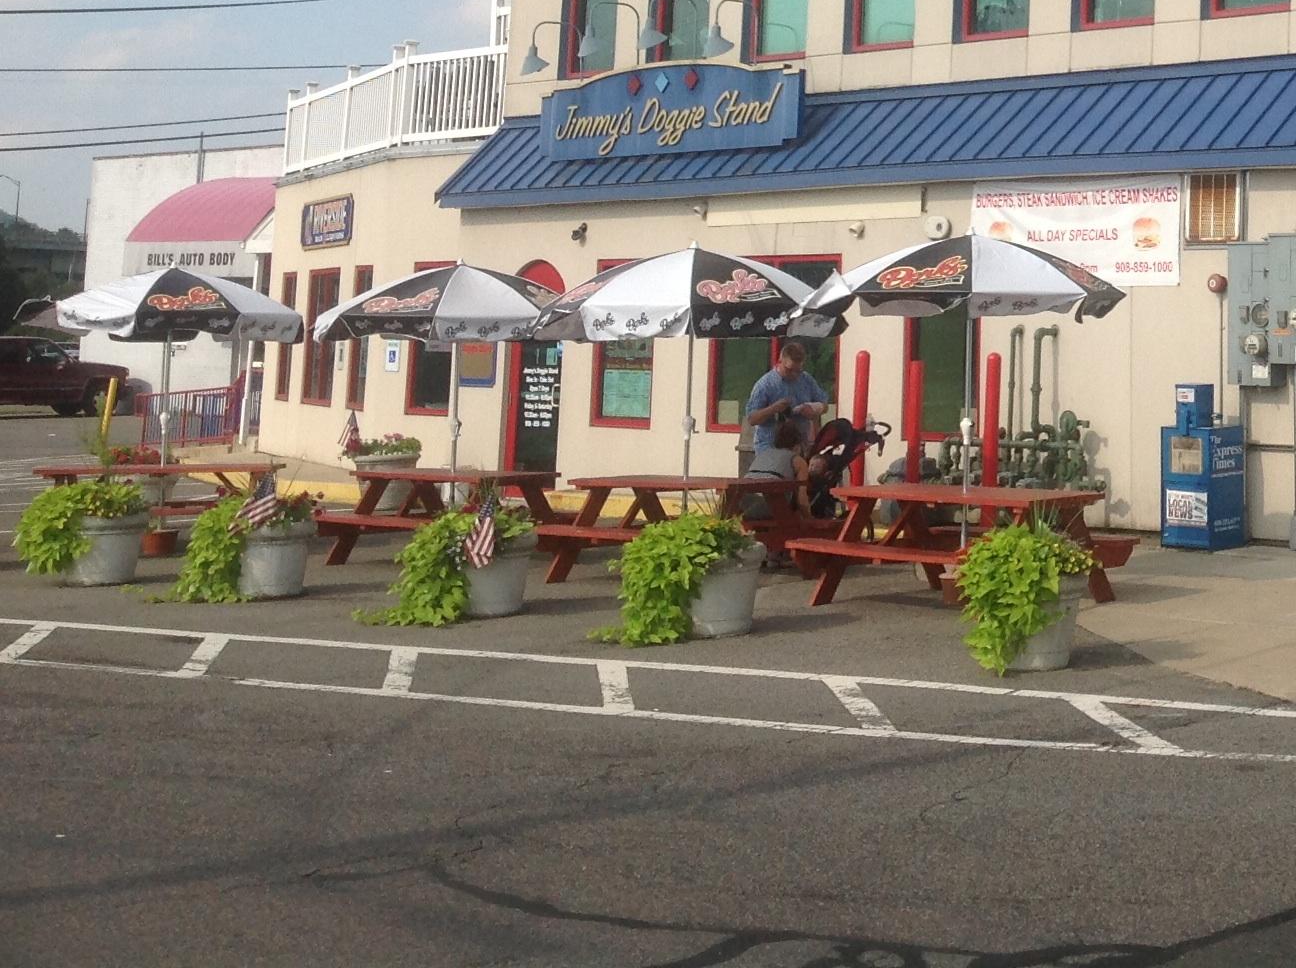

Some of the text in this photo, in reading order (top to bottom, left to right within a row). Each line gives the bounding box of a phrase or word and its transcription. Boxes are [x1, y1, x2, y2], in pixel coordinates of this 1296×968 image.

[556, 82, 784, 155] Jimmy's Doggie Stand
[1017, 193, 1043, 208] STEAK
[1092, 190, 1107, 206] ICE
[1109, 189, 1140, 205] CREAM
[1142, 187, 1178, 203] SHAKES
[1027, 228, 1119, 242] ALL DAY SPECIALS
[147, 252, 236, 266] BILL'S AUTO BODY
